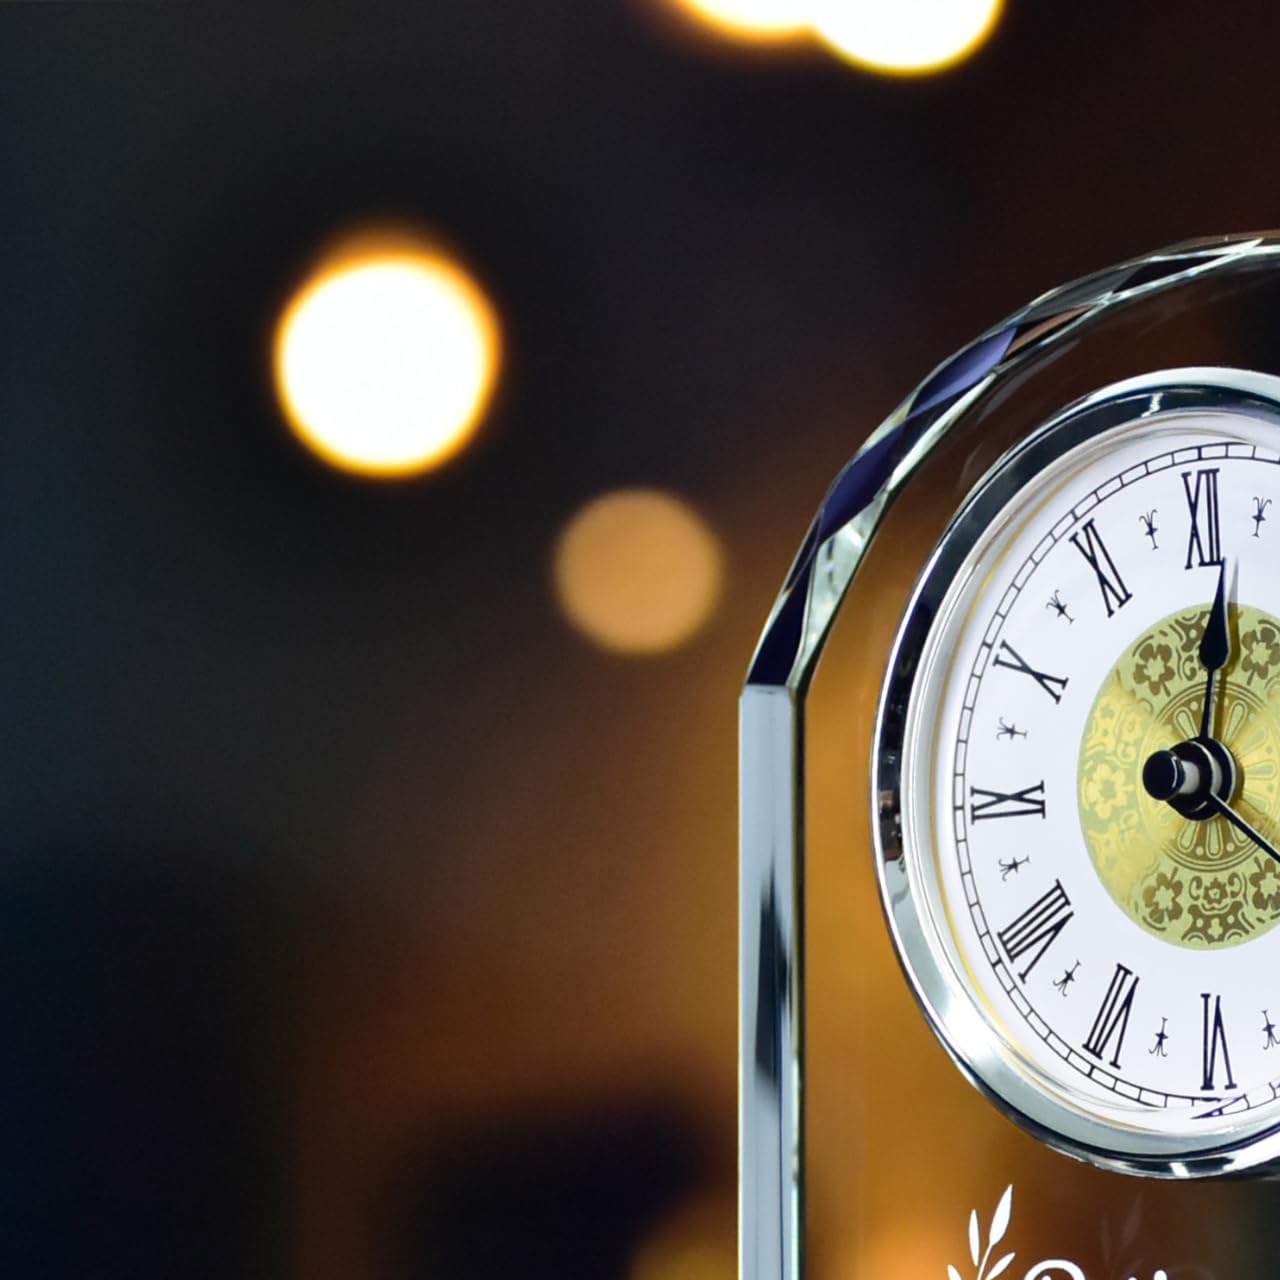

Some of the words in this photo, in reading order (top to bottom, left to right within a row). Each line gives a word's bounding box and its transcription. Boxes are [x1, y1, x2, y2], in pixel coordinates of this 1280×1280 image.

[1068, 518, 1132, 618] XI
[1181, 468, 1221, 571] XII
[992, 639, 1069, 704] X
[971, 780, 1045, 824] IX
[997, 880, 1074, 984] VIII
[1082, 963, 1140, 1069] VII
[1201, 993, 1237, 1090] VI
